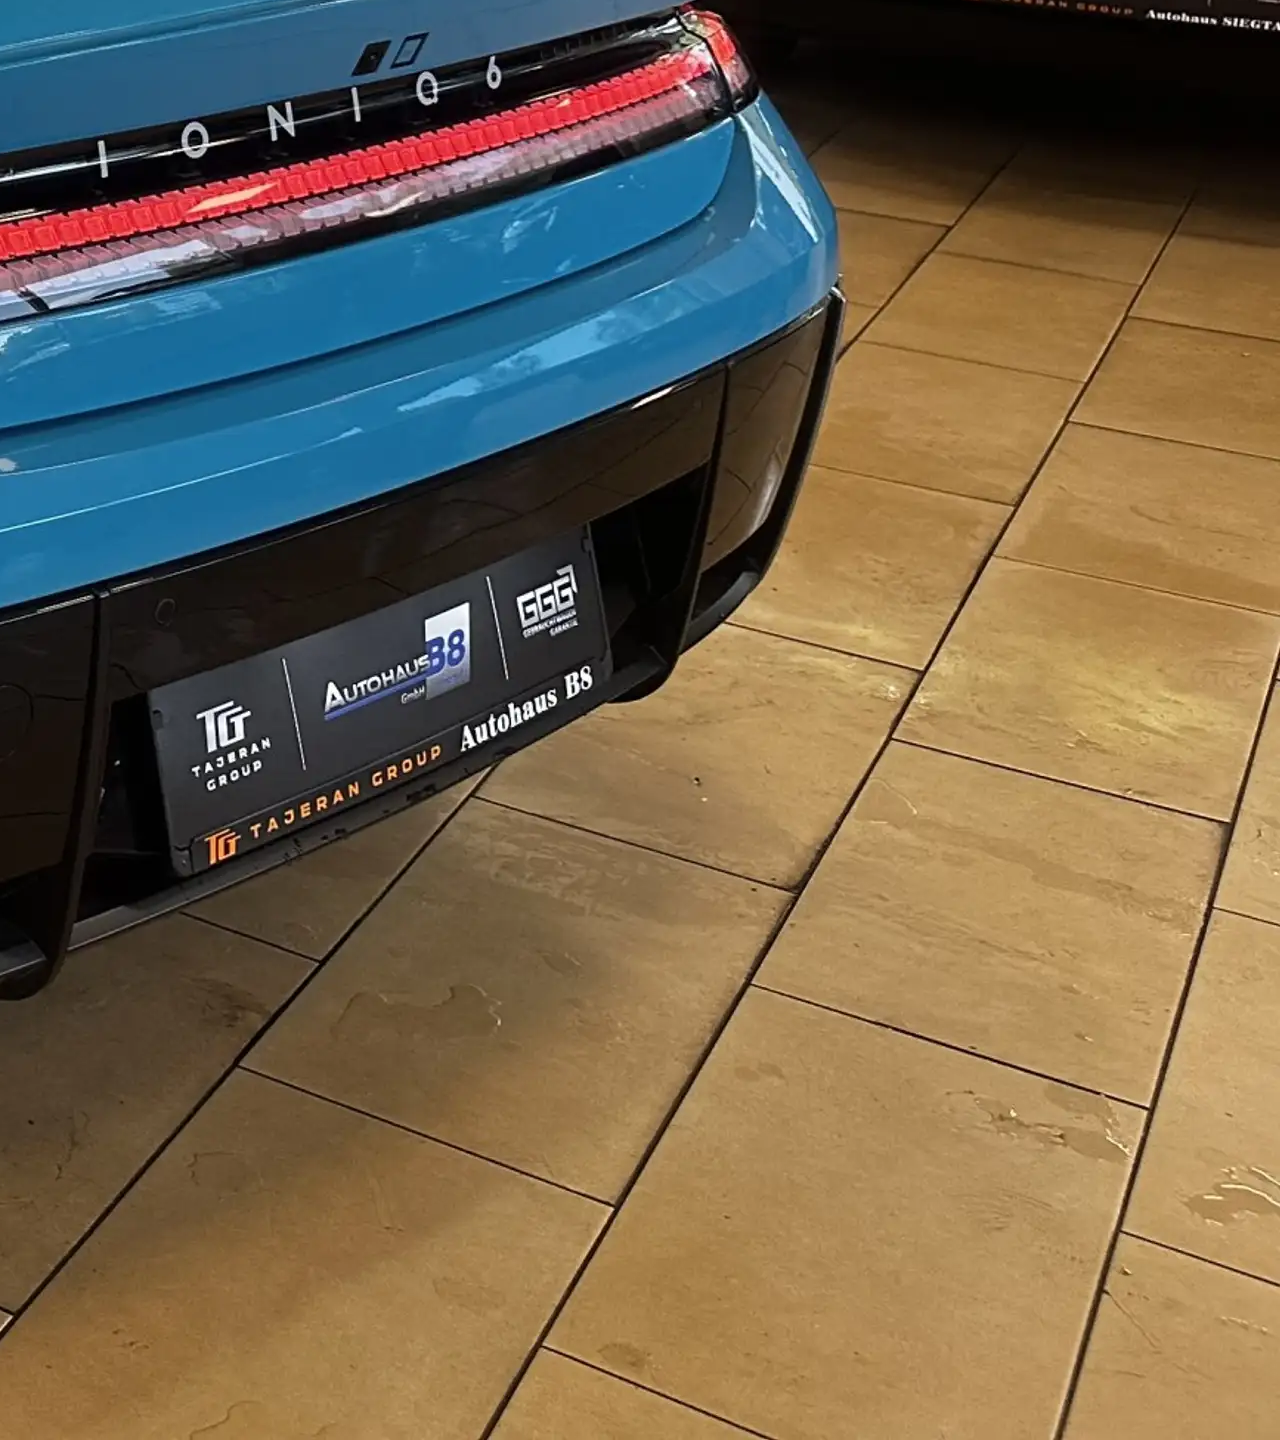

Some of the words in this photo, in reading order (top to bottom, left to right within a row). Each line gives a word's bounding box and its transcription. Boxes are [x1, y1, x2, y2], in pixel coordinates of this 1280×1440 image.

[1146, 9, 1218, 25] Autohaus
[485, 56, 502, 90] 6
[424, 627, 466, 679] B8
[400, 686, 426, 704] GmbH
[191, 737, 272, 778] TAJERAN
[250, 782, 361, 840] TAJERAN
[371, 745, 442, 788] GROUP
[460, 688, 558, 752] Autohaus
[563, 665, 594, 700] B8
[206, 759, 263, 792] GROUP
